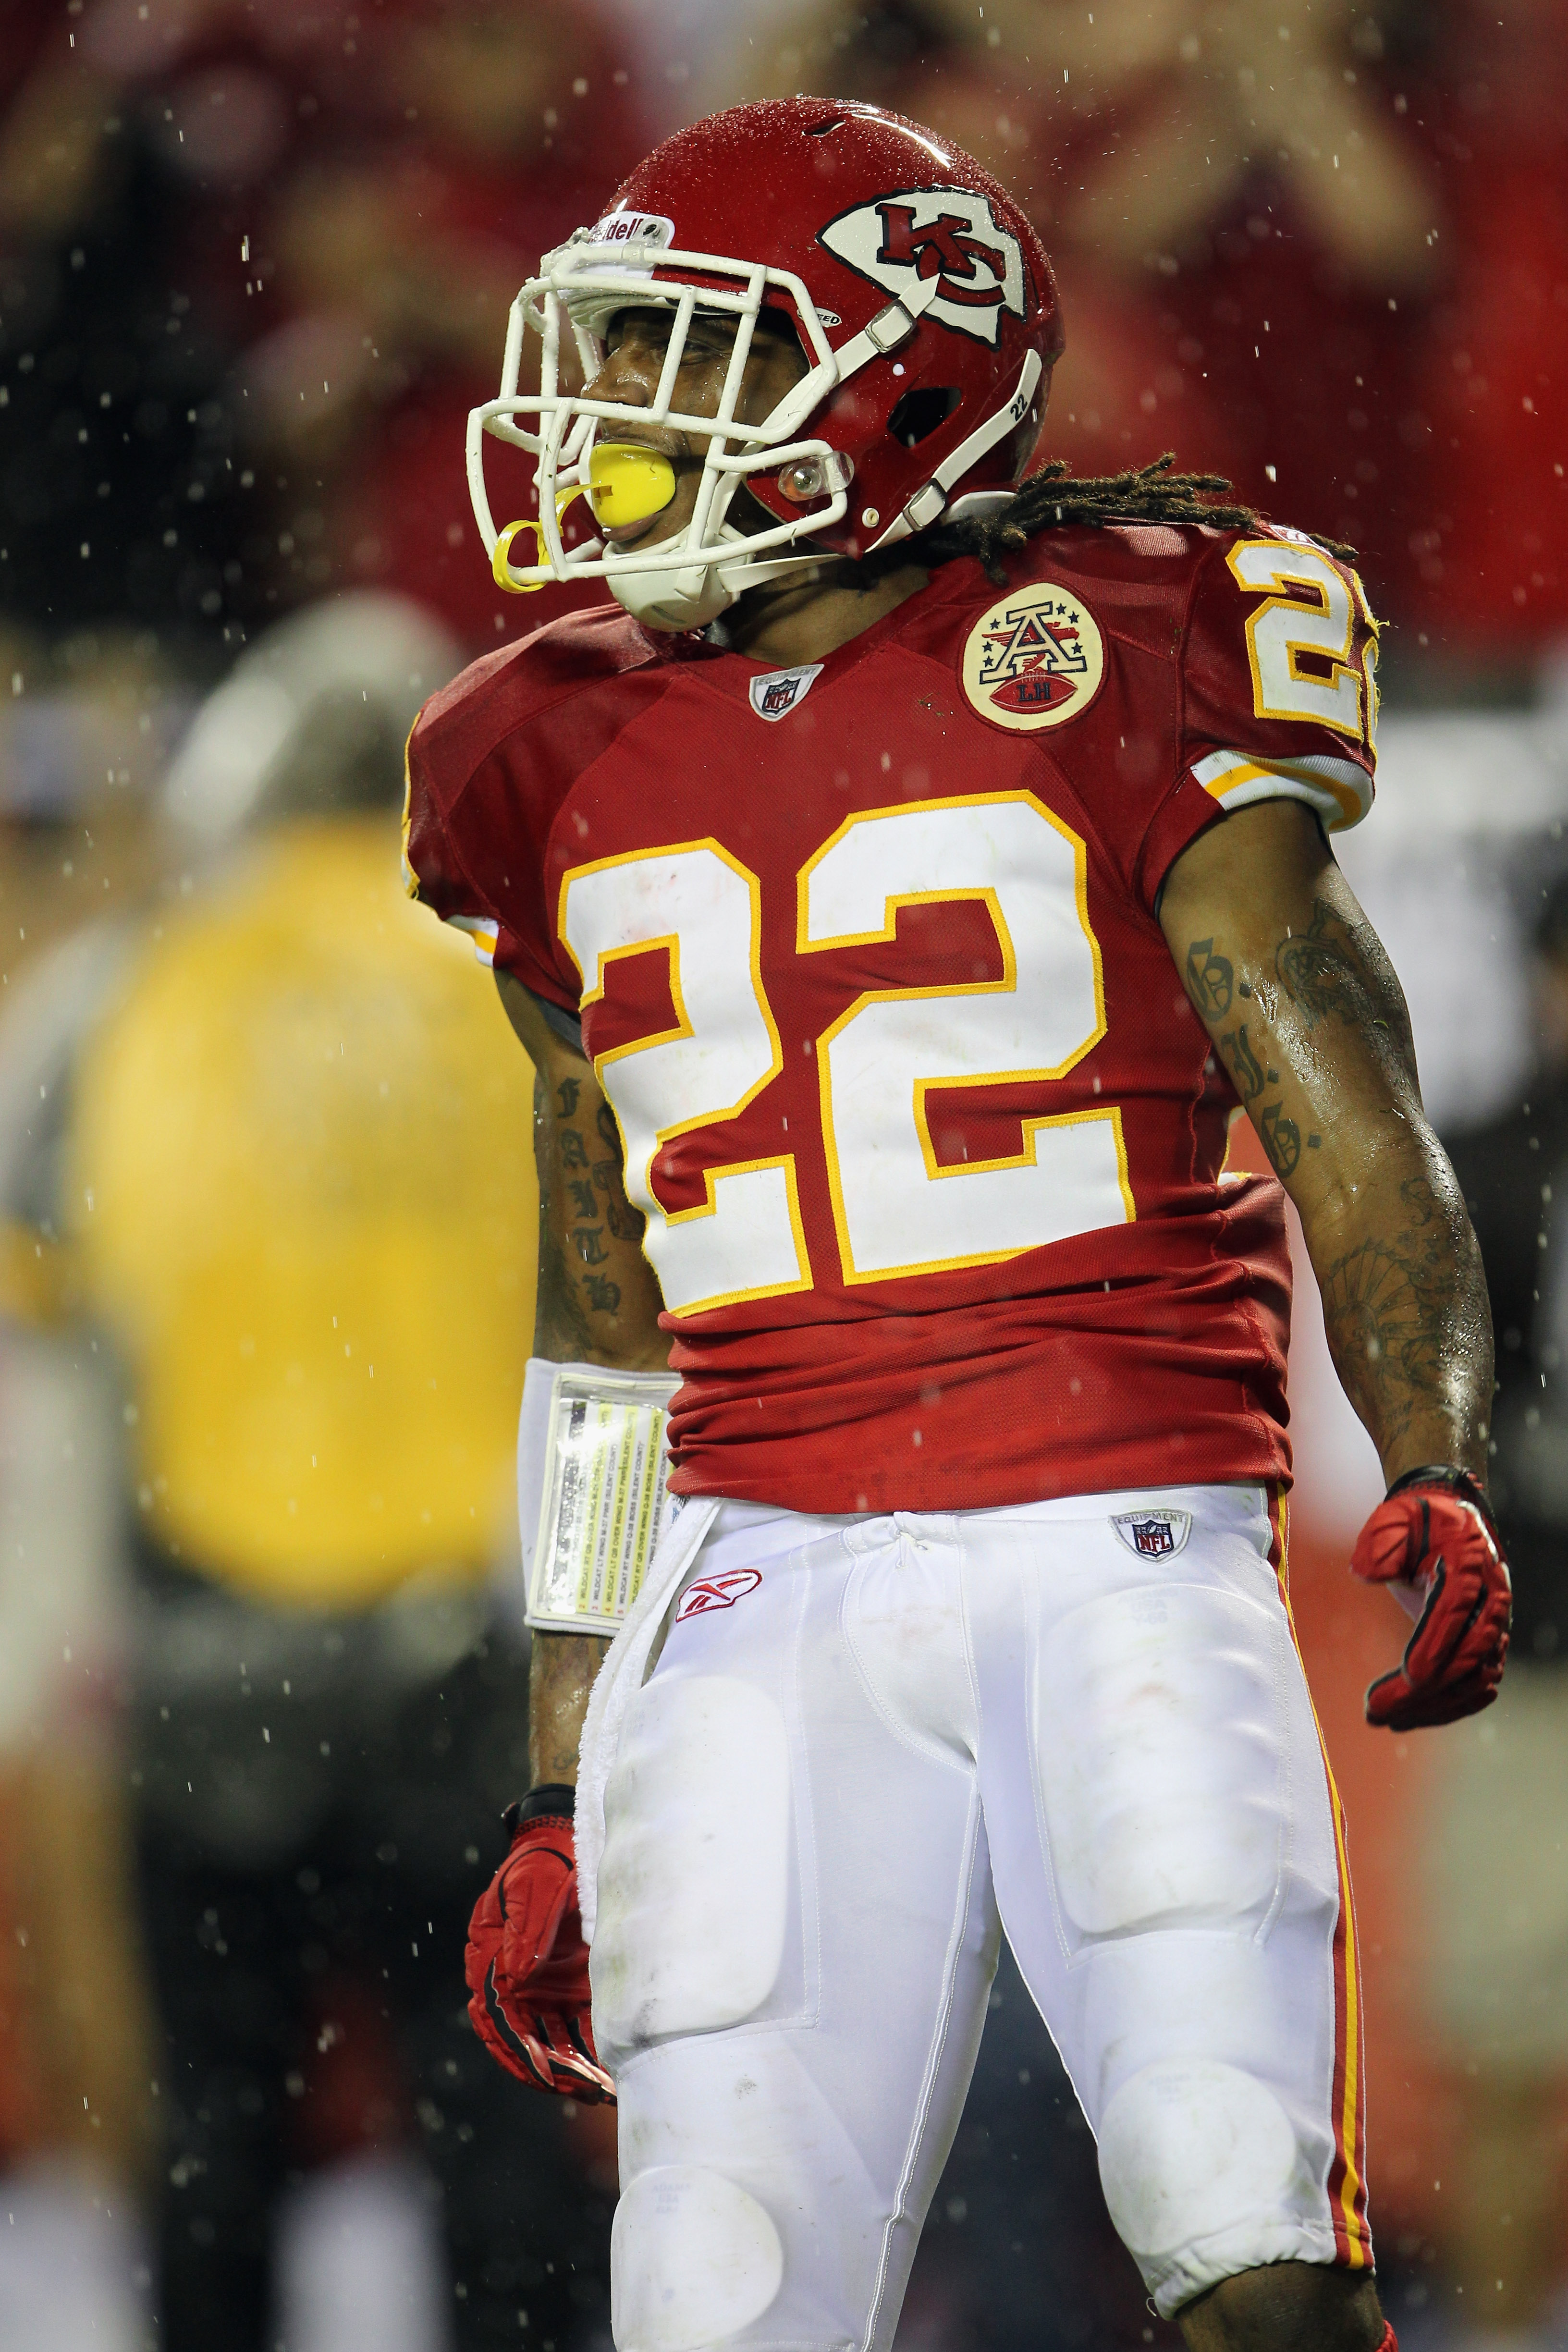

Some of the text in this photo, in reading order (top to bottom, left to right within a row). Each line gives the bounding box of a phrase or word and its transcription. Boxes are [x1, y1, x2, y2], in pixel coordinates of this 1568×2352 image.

[1010, 394, 1028, 421] 22
[980, 601, 1087, 684] A
[766, 690, 792, 709] NFL
[1017, 683, 1051, 701] LH
[557, 789, 1137, 1318] 22
[1117, 1512, 1183, 1524] EQUIPMENT
[1138, 1535, 1170, 1552] NFL
[592, 1568, 602, 1601] WILDCAT
[597, 1558, 603, 1567] LT
[605, 1570, 615, 1603] WILDCAT
[610, 1560, 616, 1568] LT
[618, 1572, 628, 1605] WILDCAT
